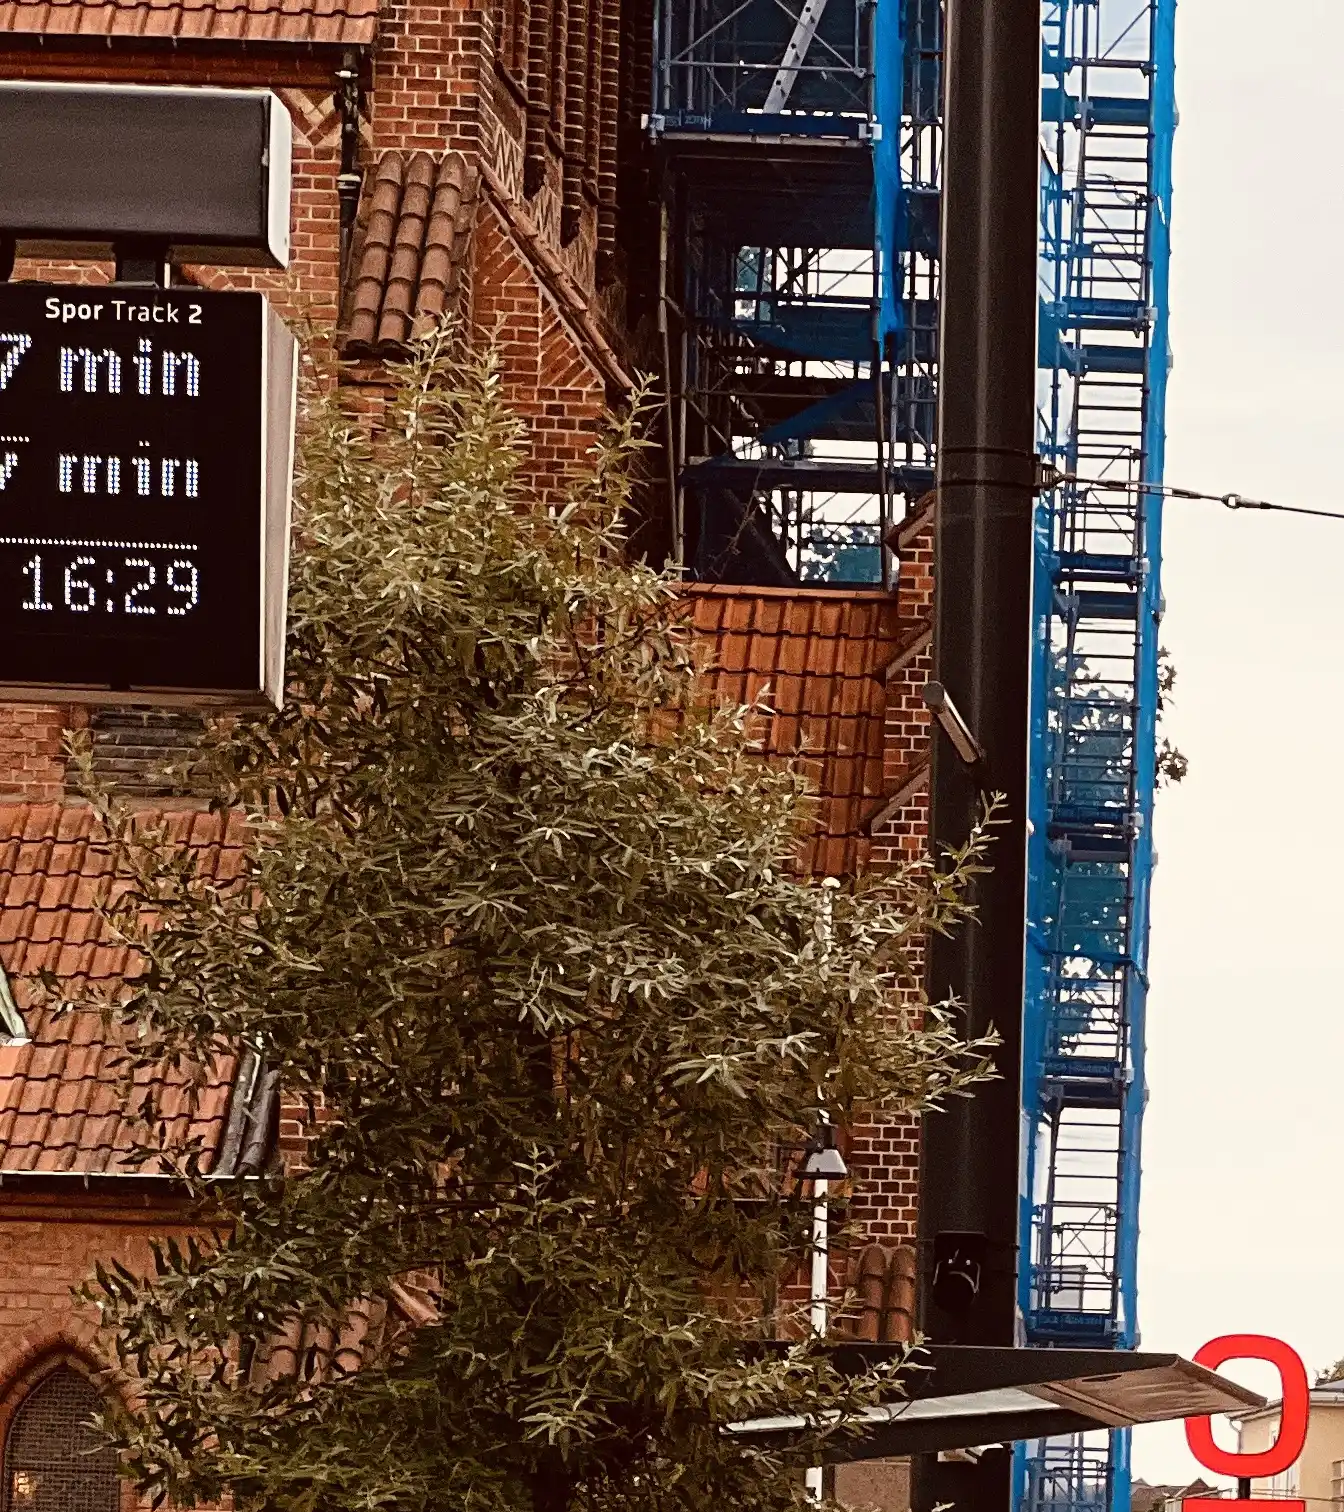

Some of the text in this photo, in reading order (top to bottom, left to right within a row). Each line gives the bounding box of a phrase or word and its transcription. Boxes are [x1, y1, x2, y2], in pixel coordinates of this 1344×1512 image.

[45, 298, 203, 325] Spor Track 2
[58, 337, 200, 397] min
[58, 440, 200, 497] min
[21, 554, 200, 616] 16:29
